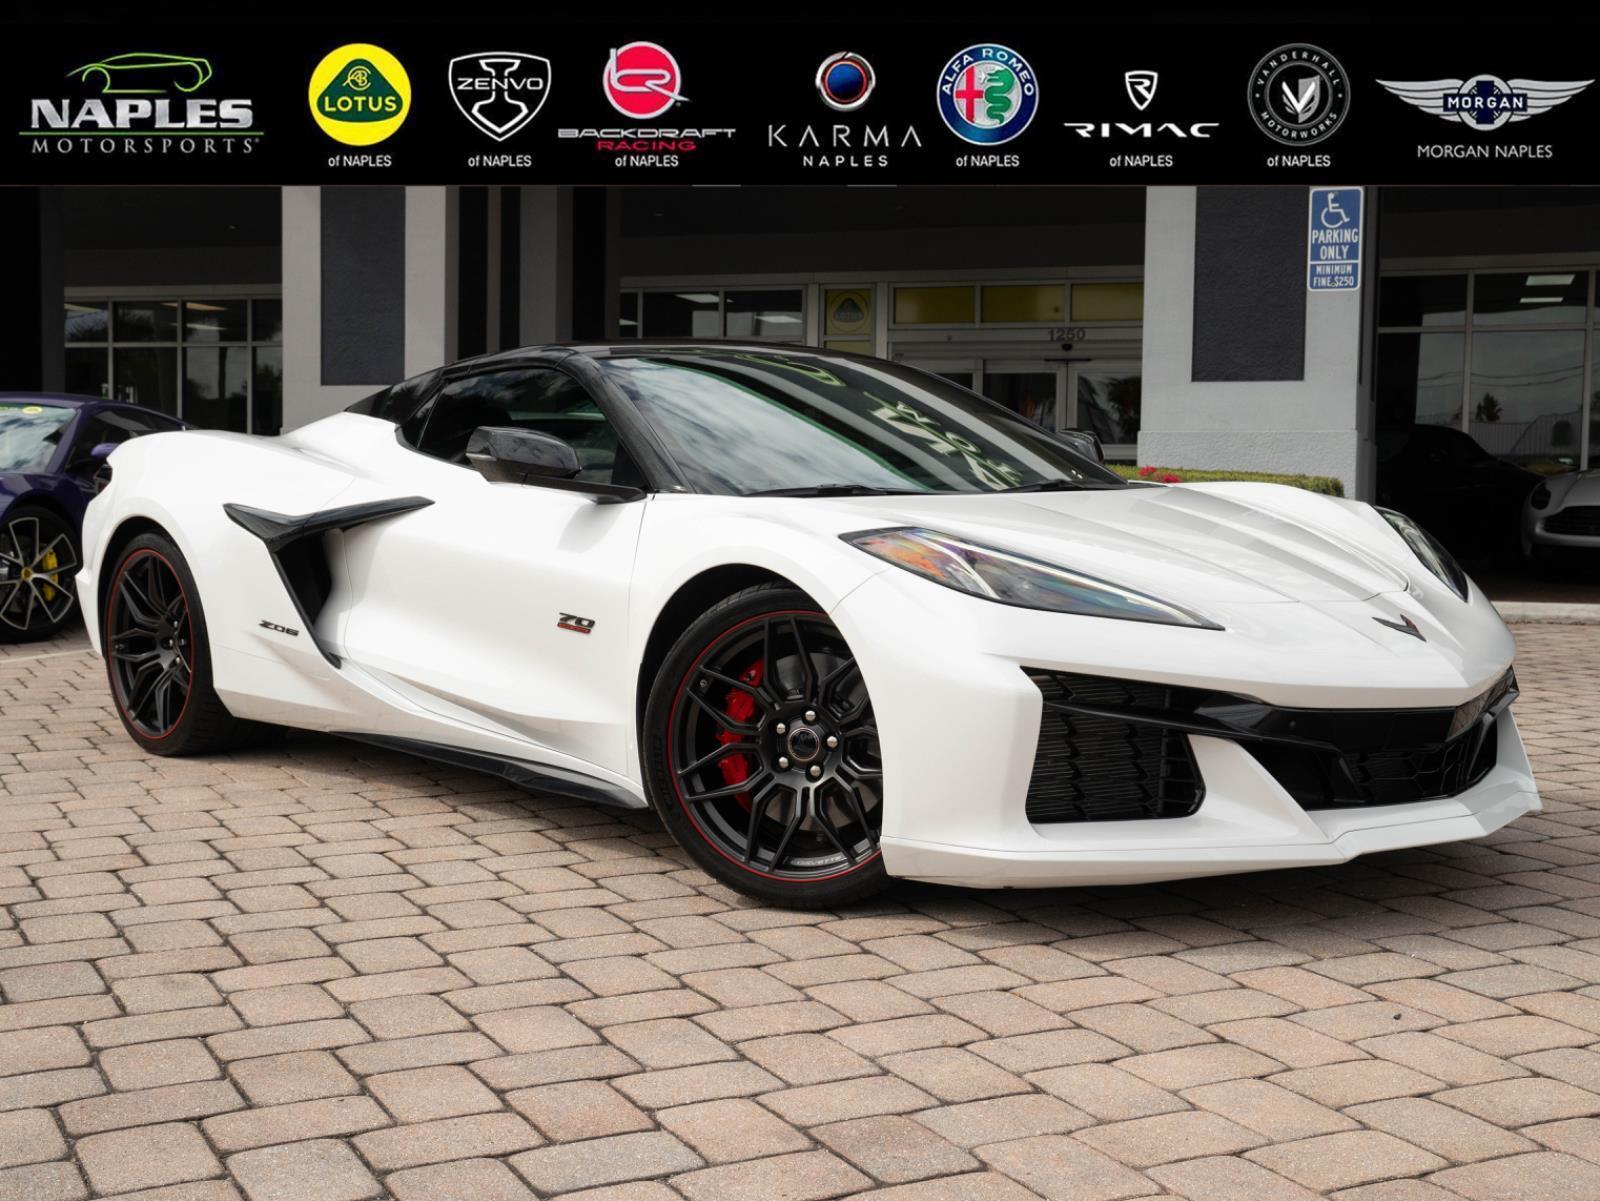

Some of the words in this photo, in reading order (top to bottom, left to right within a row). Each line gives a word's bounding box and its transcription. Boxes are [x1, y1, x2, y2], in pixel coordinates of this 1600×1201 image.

[1312, 228, 1358, 244] PARKING
[1320, 245, 1349, 260] ONLY
[1316, 264, 1352, 275] MINIMUM
[1313, 277, 1332, 287] FINE
[1335, 276, 1354, 287] $250
[1048, 327, 1086, 342] 1250
[258, 619, 300, 637] Z06
[559, 612, 595, 629] 70
